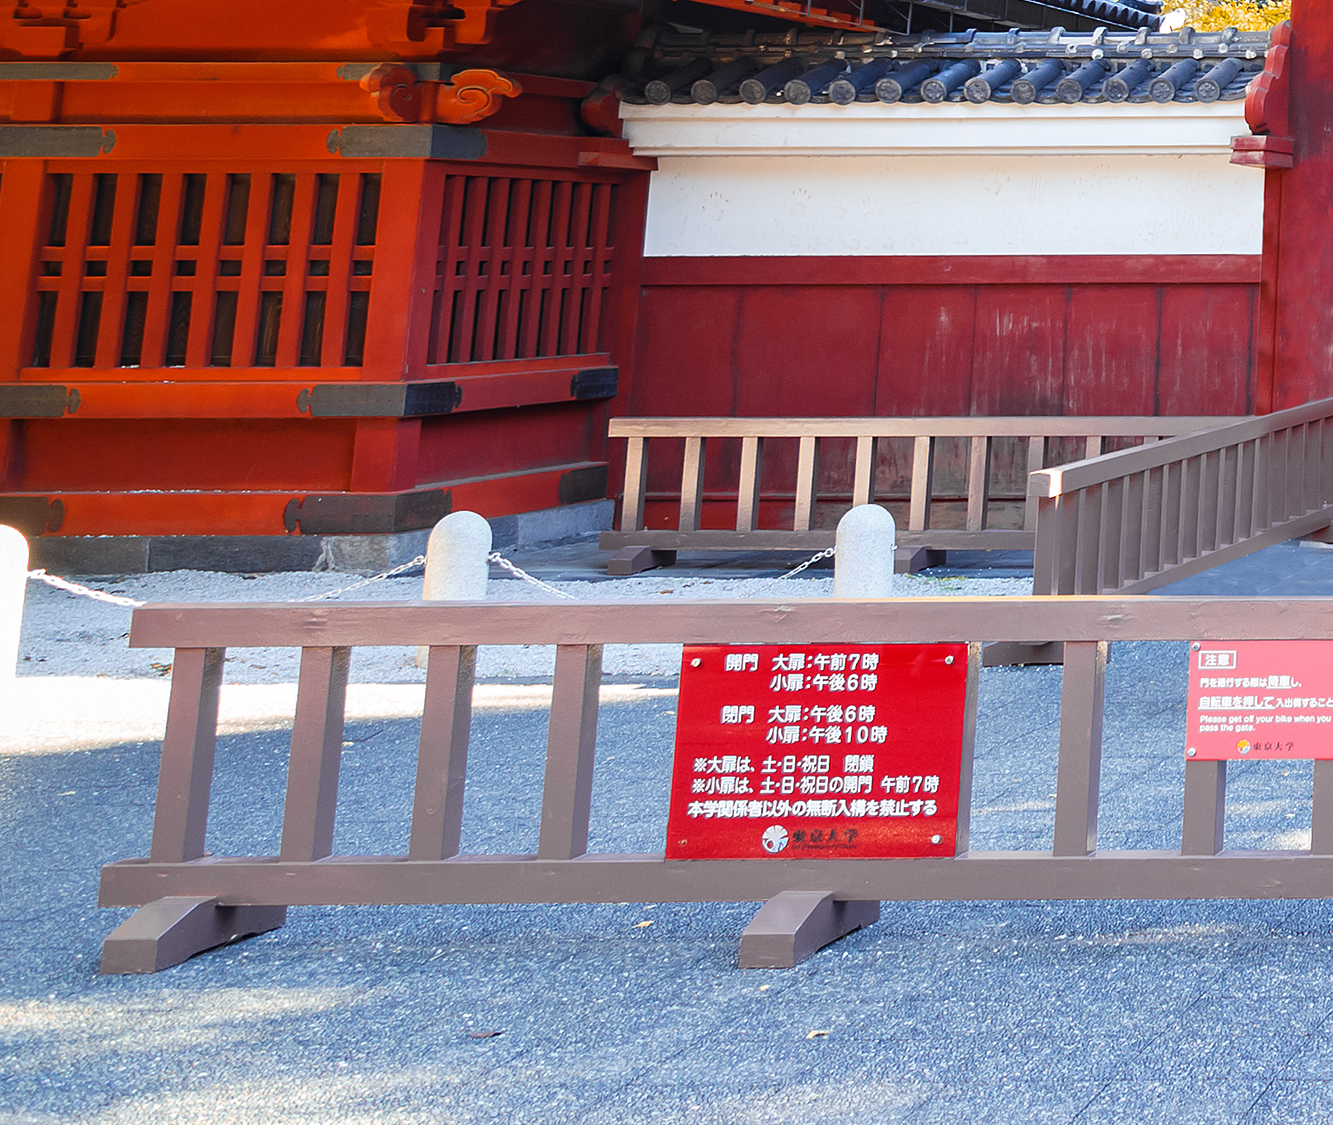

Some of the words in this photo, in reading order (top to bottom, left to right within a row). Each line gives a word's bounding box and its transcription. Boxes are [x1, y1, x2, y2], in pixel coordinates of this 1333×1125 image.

[726, 654, 758, 671] 開門
[1205, 654, 1229, 666] 注意
[721, 706, 754, 723] 閉門
[1200, 715, 1226, 723] Please
[1244, 715, 1254, 723] off
[1256, 716, 1273, 724] your
[844, 755, 874, 772] 閉鎖
[881, 775, 939, 793] 午前７時
